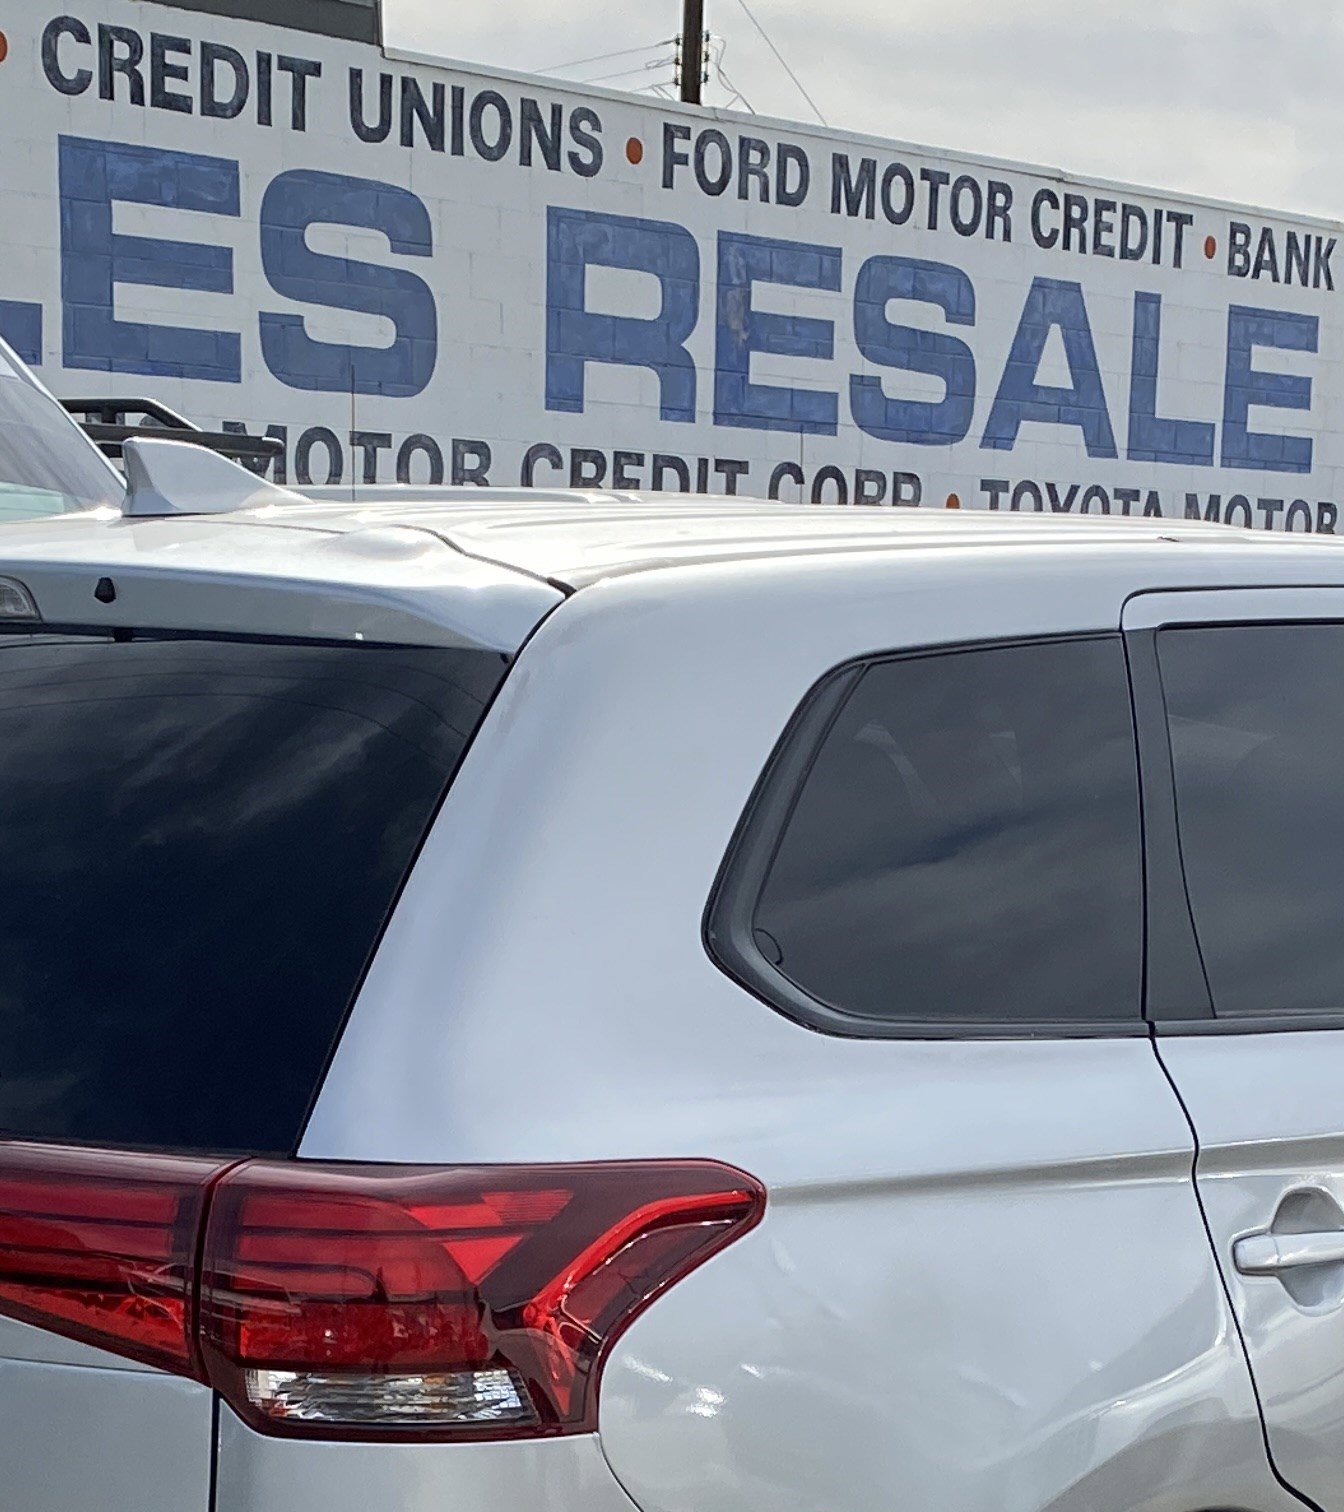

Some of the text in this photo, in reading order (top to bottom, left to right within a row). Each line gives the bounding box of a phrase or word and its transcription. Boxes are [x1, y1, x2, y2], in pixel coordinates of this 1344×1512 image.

[41, 14, 322, 132] CREDIT
[348, 66, 604, 178] UNIONS
[661, 122, 811, 208] FORD
[830, 153, 1013, 244] MOTOR
[1029, 187, 1194, 270] CREDIT
[1226, 221, 1338, 292] BANK
[544, 205, 1320, 474] RESALE
